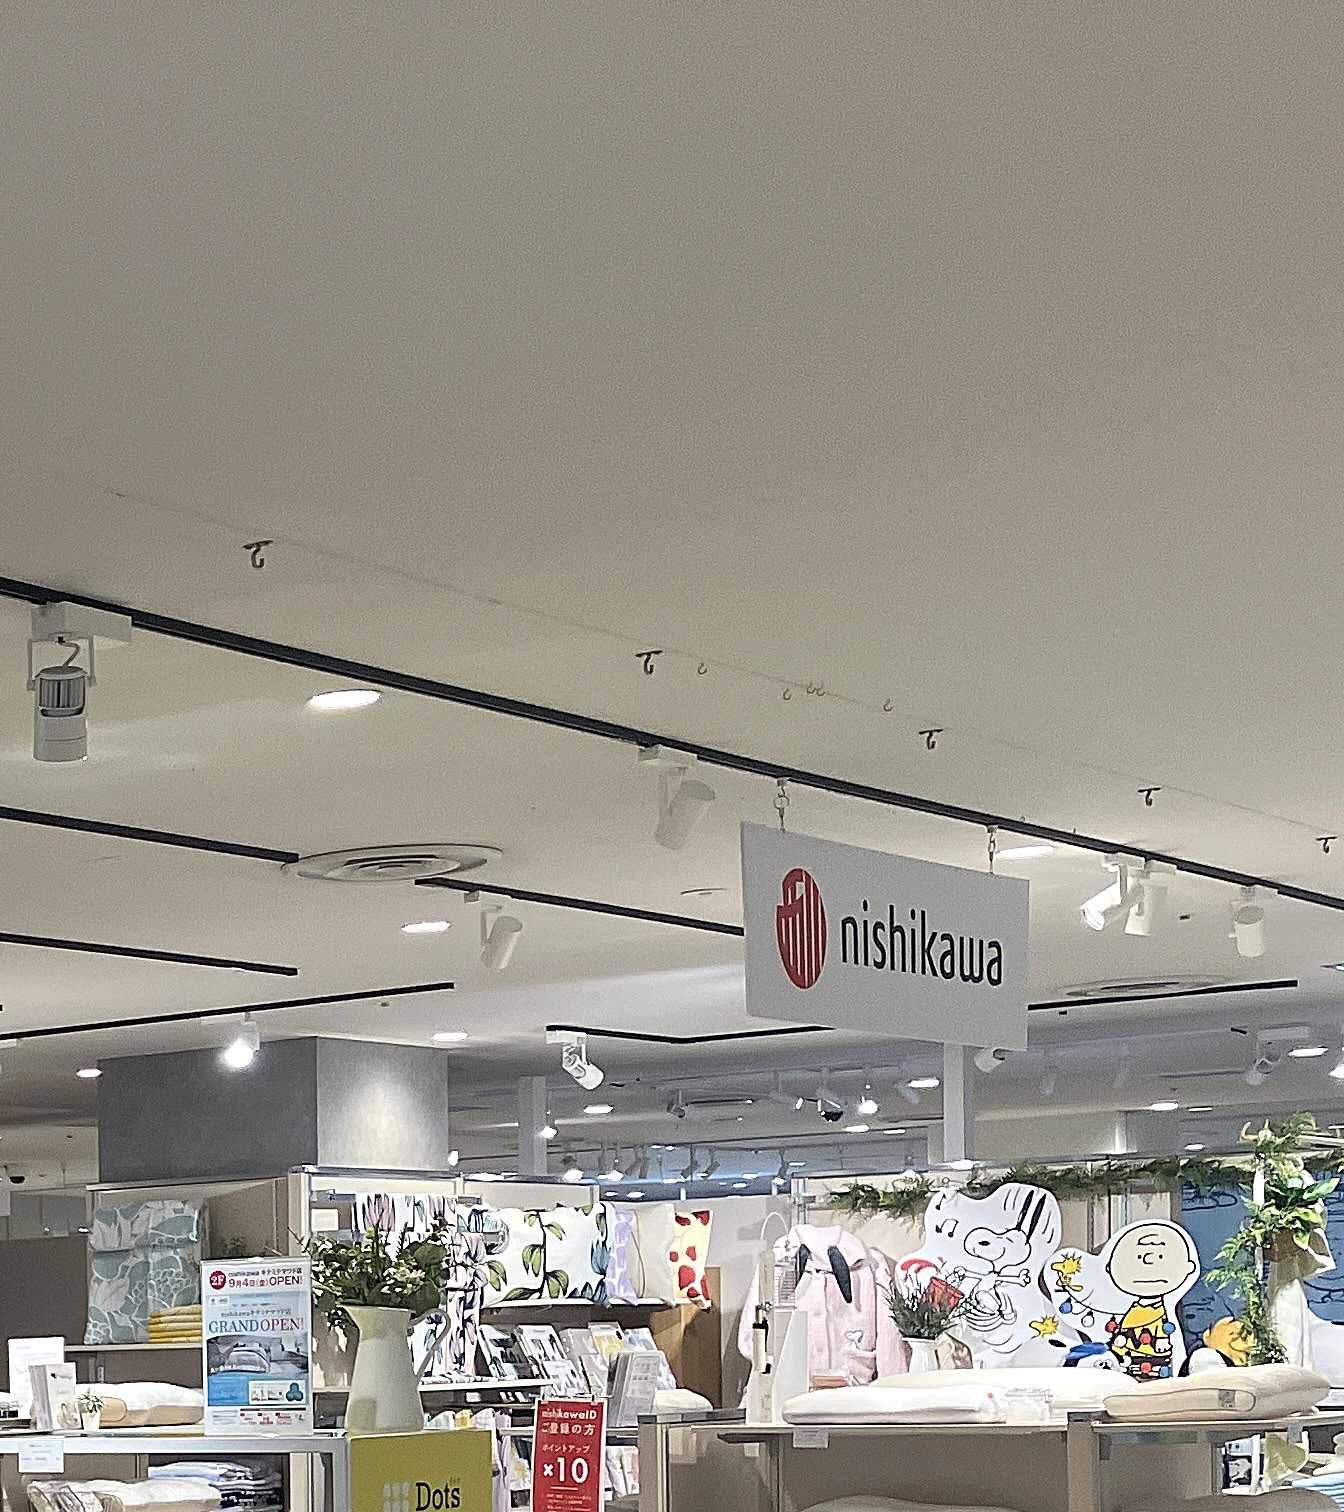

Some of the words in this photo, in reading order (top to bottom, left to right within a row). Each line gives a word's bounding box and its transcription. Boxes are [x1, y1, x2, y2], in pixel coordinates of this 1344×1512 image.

[841, 899, 1002, 987] nishikawa
[541, 1422, 595, 1435] ご登録の方
[415, 1482, 461, 1511] Dots
